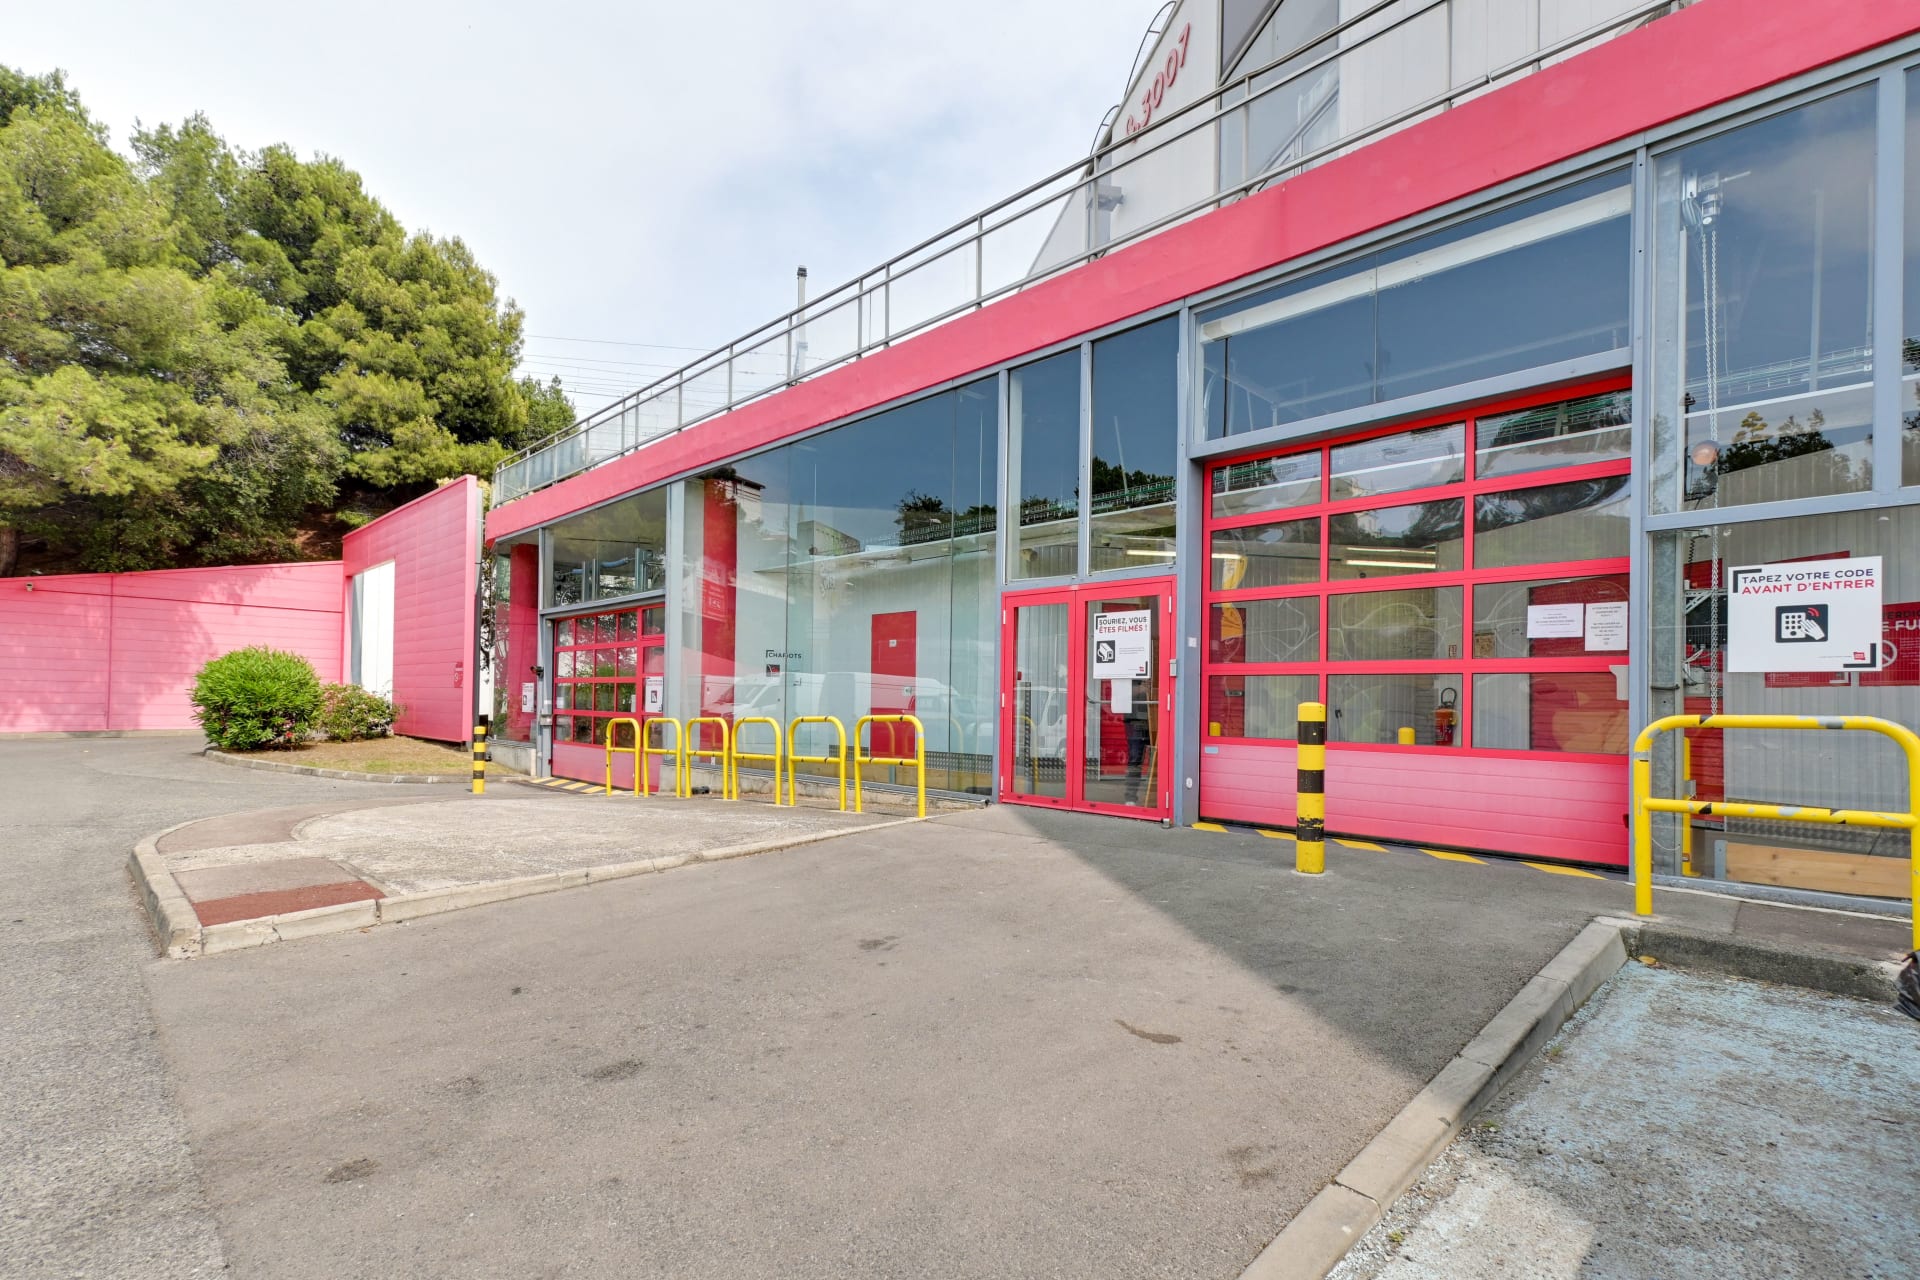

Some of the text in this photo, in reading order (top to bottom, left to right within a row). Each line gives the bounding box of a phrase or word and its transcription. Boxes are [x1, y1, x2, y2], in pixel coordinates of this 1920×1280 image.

[1742, 568, 1874, 584] TAPEZ VOTRE CODE
[1742, 579, 1875, 595] AVANT D'ENTRER
[1895, 619, 1920, 631] FU
